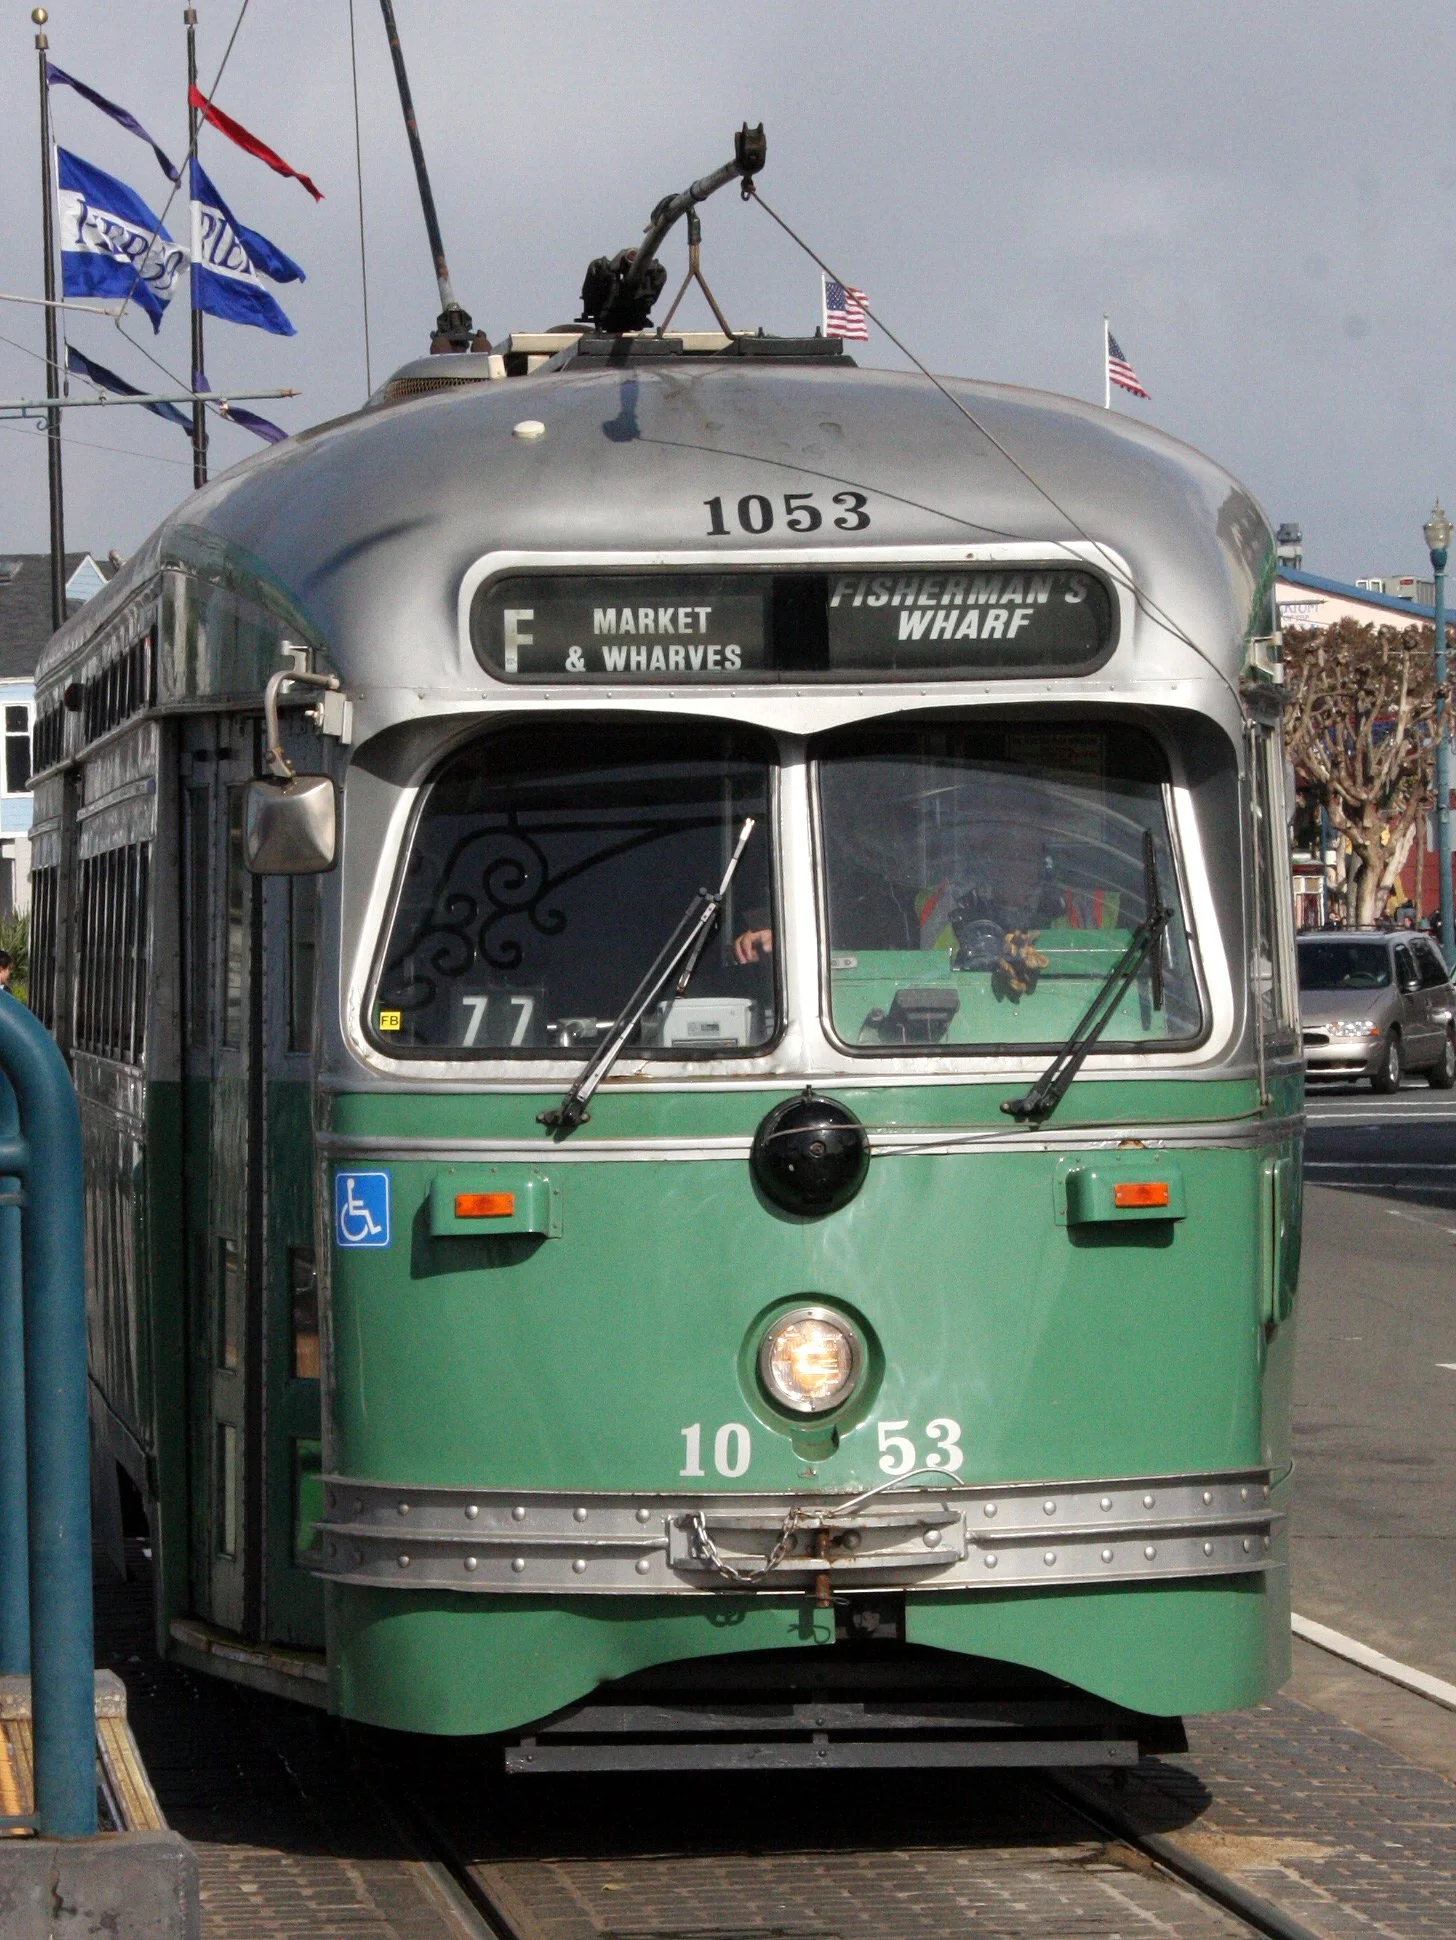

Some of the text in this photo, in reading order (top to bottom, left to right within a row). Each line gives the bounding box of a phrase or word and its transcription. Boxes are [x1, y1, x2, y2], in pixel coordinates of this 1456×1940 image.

[703, 491, 871, 536] 1053
[829, 573, 1088, 608] FISHERMAN'S
[593, 607, 712, 634] MARKET
[898, 608, 1034, 641] WHARF
[504, 609, 534, 673] F
[565, 644, 742, 672] & WHARVES
[381, 1015, 399, 1026] FB
[679, 1418, 963, 1477] 10 53
